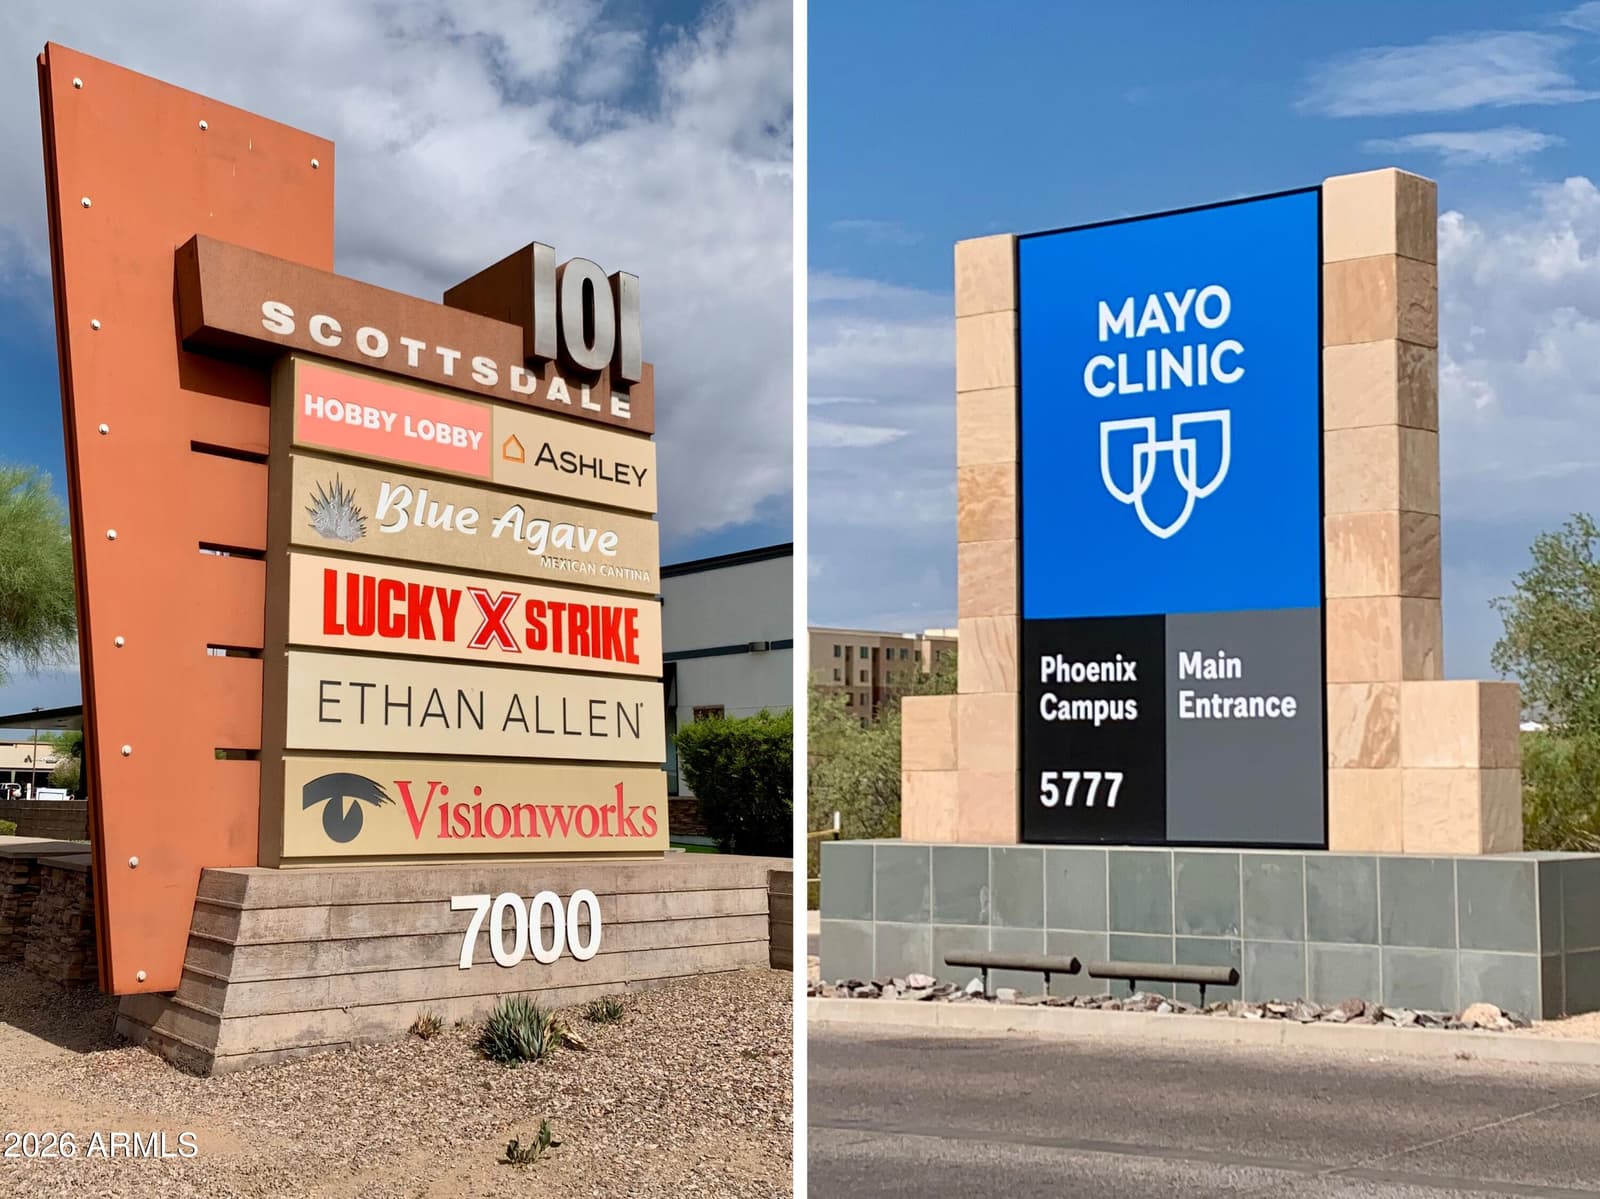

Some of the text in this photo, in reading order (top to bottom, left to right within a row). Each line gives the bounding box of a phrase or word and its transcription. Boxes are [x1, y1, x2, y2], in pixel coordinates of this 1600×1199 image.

[531, 241, 642, 384] 101
[1098, 284, 1232, 342] MAYO
[261, 300, 632, 419] SCOTTSDALE
[1083, 339, 1246, 398] CLINIC
[304, 393, 484, 451] HOBBY LOBBY
[534, 442, 648, 487] ASHLEY
[375, 482, 619, 556] Blue Agave
[540, 556, 651, 583] MEXICAN CANTINA
[323, 568, 462, 642] LUCKY
[525, 599, 640, 665] STRIKE
[1040, 654, 1138, 683] Phoenix
[1178, 650, 1243, 680] Main
[318, 679, 641, 739] ETHAN ALLEN
[1039, 692, 1139, 727] Campus
[1178, 690, 1298, 719] Entrance
[393, 780, 658, 840] Visionworks
[1039, 771, 1124, 808] 5777
[450, 889, 602, 970] 7000
